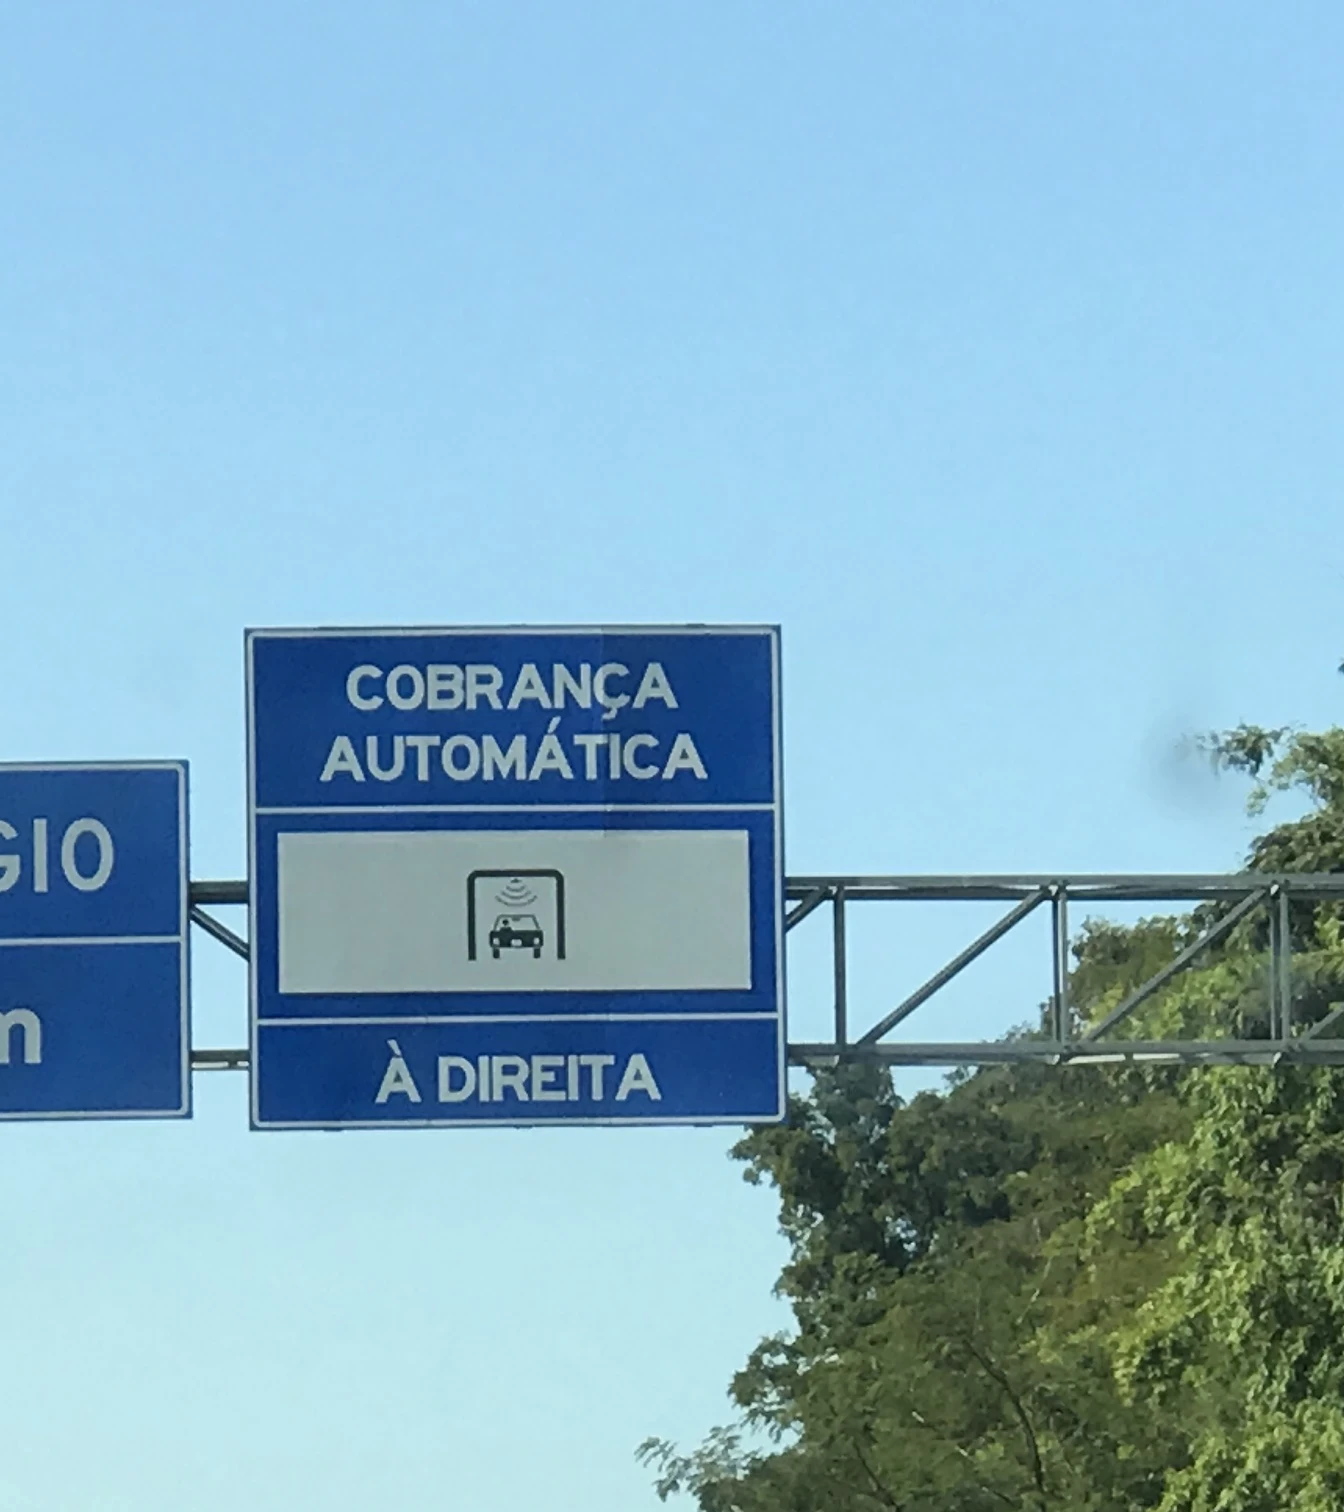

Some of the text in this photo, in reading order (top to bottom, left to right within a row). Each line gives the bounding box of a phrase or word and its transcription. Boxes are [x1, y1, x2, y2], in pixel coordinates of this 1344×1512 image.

[345, 662, 679, 720] COBRANÇA
[319, 716, 709, 783] AUTOMÁTICA
[375, 1039, 662, 1104] À DIREITA
